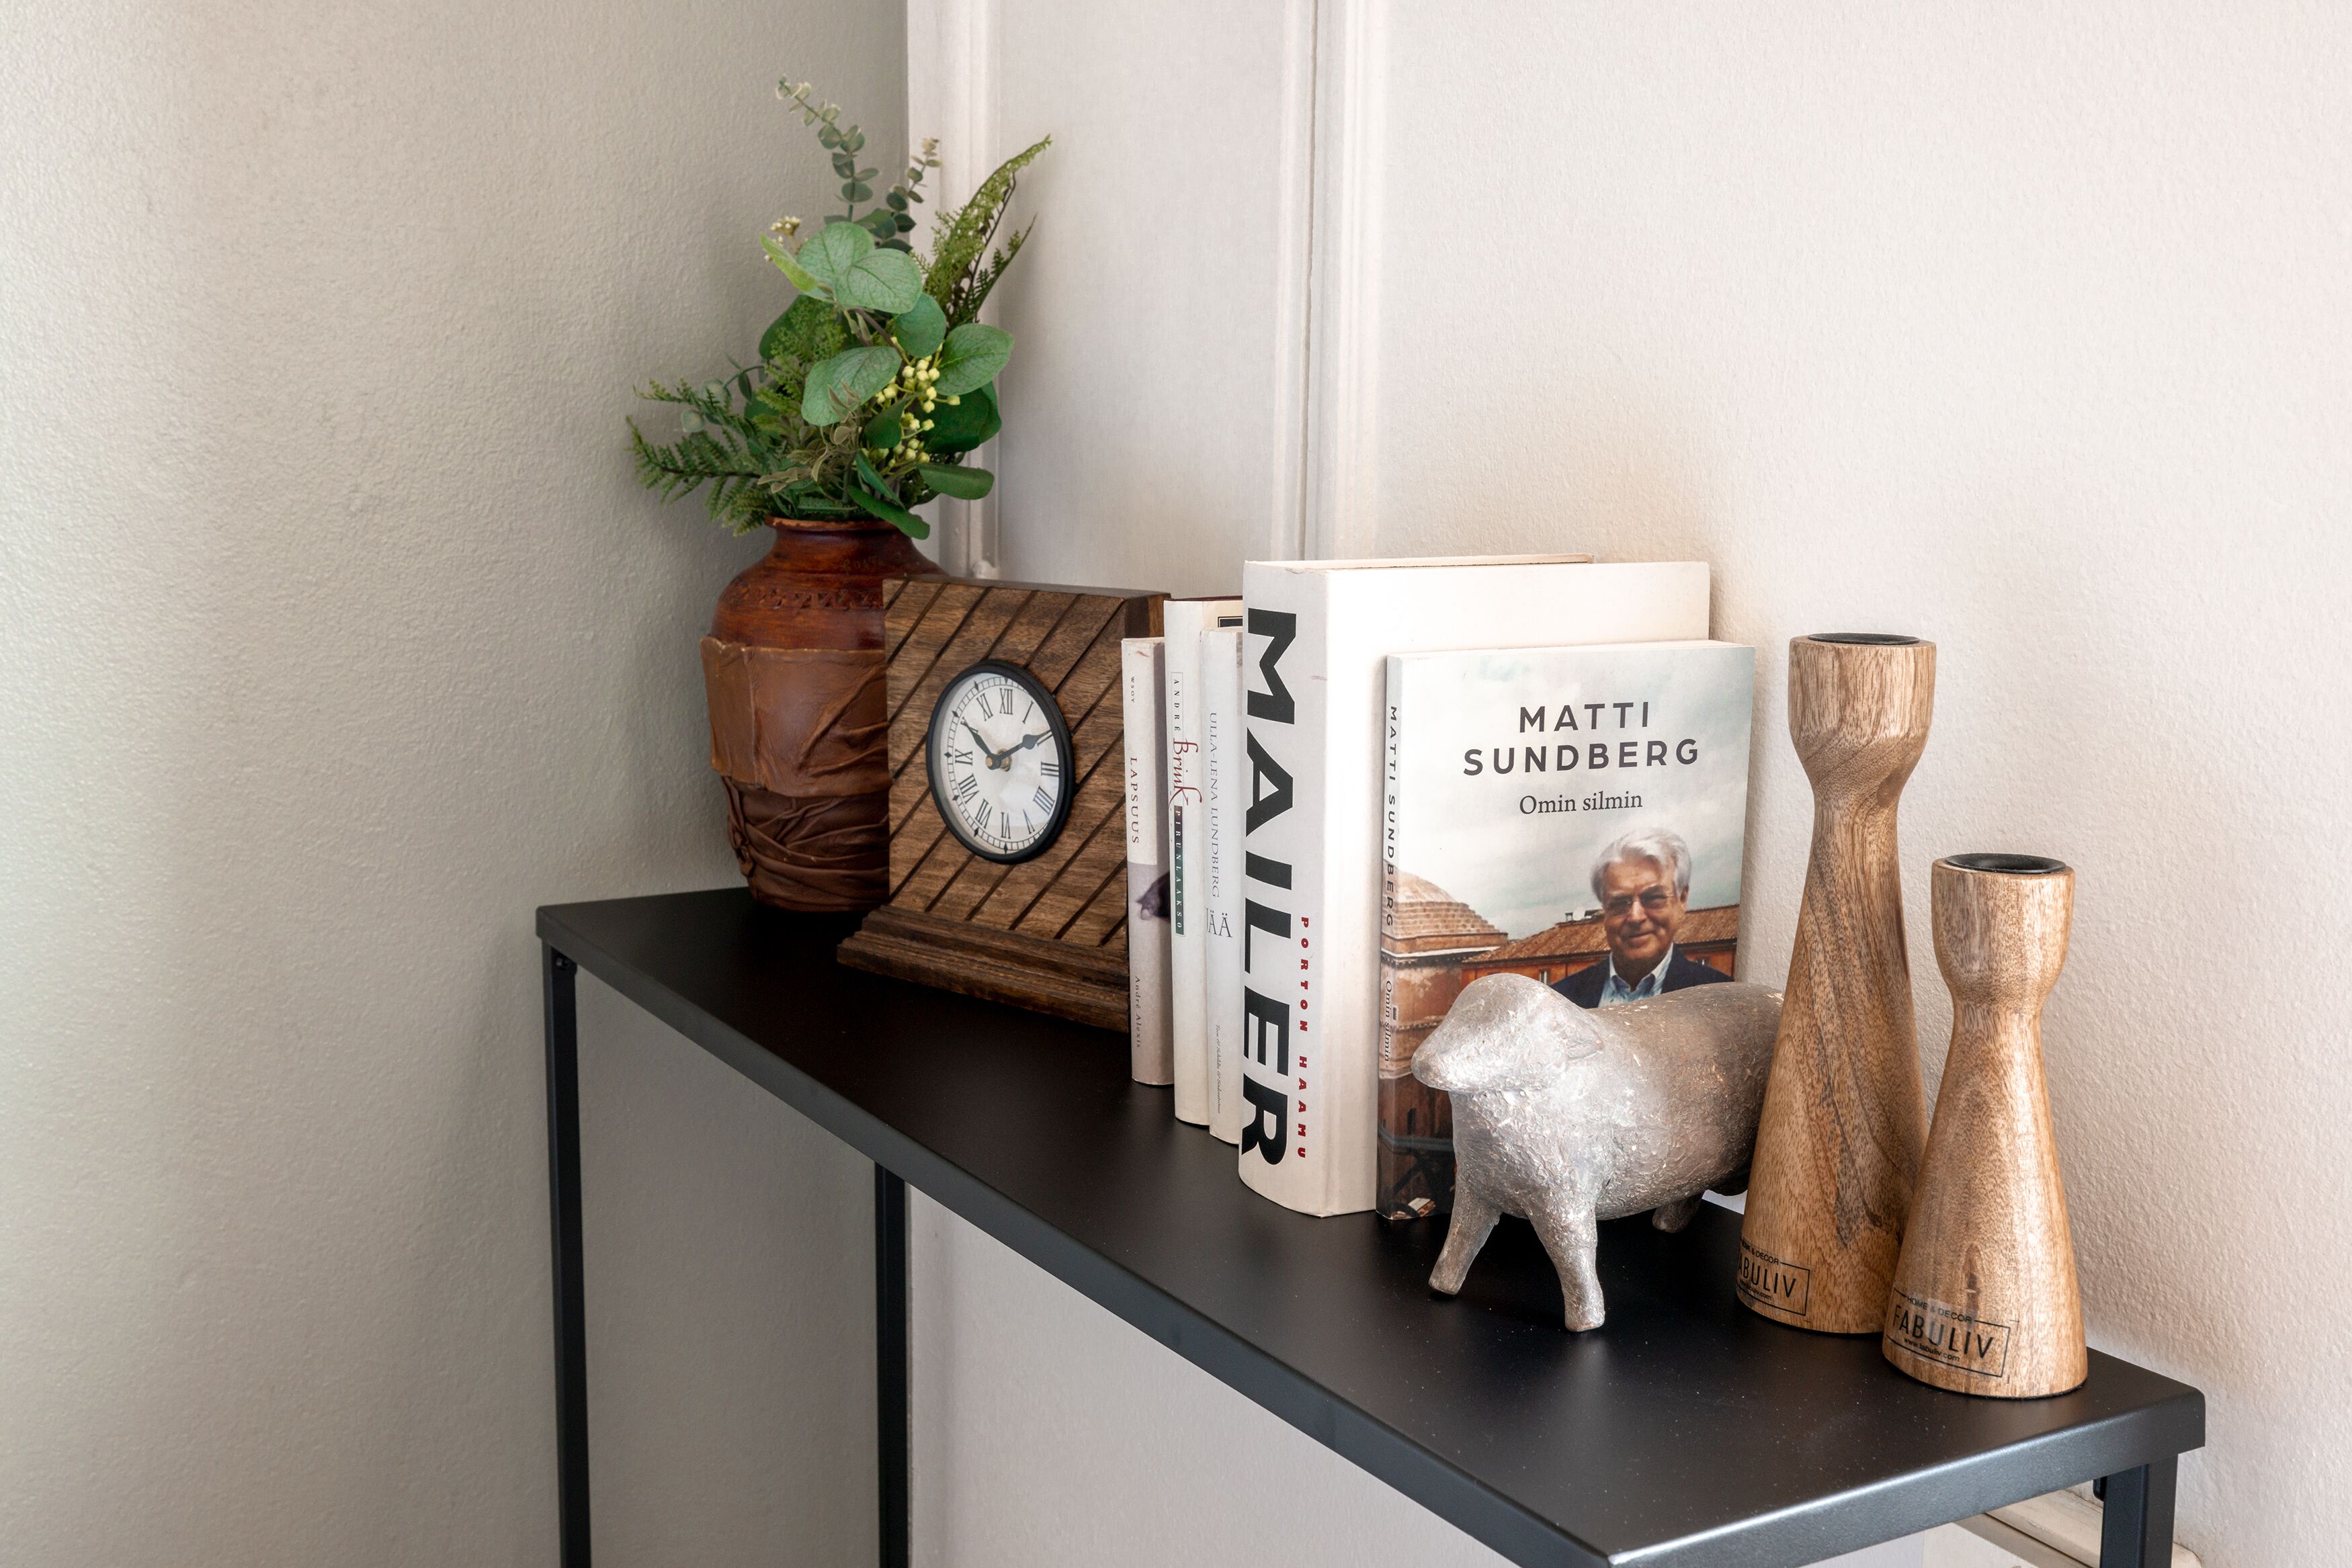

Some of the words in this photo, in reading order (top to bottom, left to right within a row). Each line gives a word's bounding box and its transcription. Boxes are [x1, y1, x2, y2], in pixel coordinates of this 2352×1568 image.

[976, 693, 993, 721] XI
[999, 687, 1013, 715] XII
[1173, 679, 1181, 732] ANDRÉ
[1519, 701, 1648, 733] MATTI
[955, 748, 973, 766] IX
[1040, 761, 1059, 777] III
[1210, 712, 1218, 801] ULLA-LENA
[1389, 705, 1397, 781] MATTI
[1464, 738, 1697, 776] SUNDBERG
[1169, 738, 1202, 805] Brink
[1130, 757, 1140, 844] LAPSUUS
[1519, 794, 1577, 815] Omin
[1583, 791, 1643, 812] silmin
[1175, 810, 1183, 928] PIRUNLAAKSO
[1210, 806, 1220, 898] LUNDBERG
[1386, 794, 1396, 926] SUNDBERG
[1241, 607, 1297, 1166] MAILER
[1300, 916, 1310, 1032] PORTON
[1297, 1055, 1308, 1158] HAAMU
[1738, 1252, 1796, 1298] ABULIV
[1755, 1250, 1779, 1265] DECOR
[1892, 1304, 1994, 1359] FABULIV
[1907, 1295, 1929, 1310] HOME
[1938, 1307, 1972, 1324] DECOR
